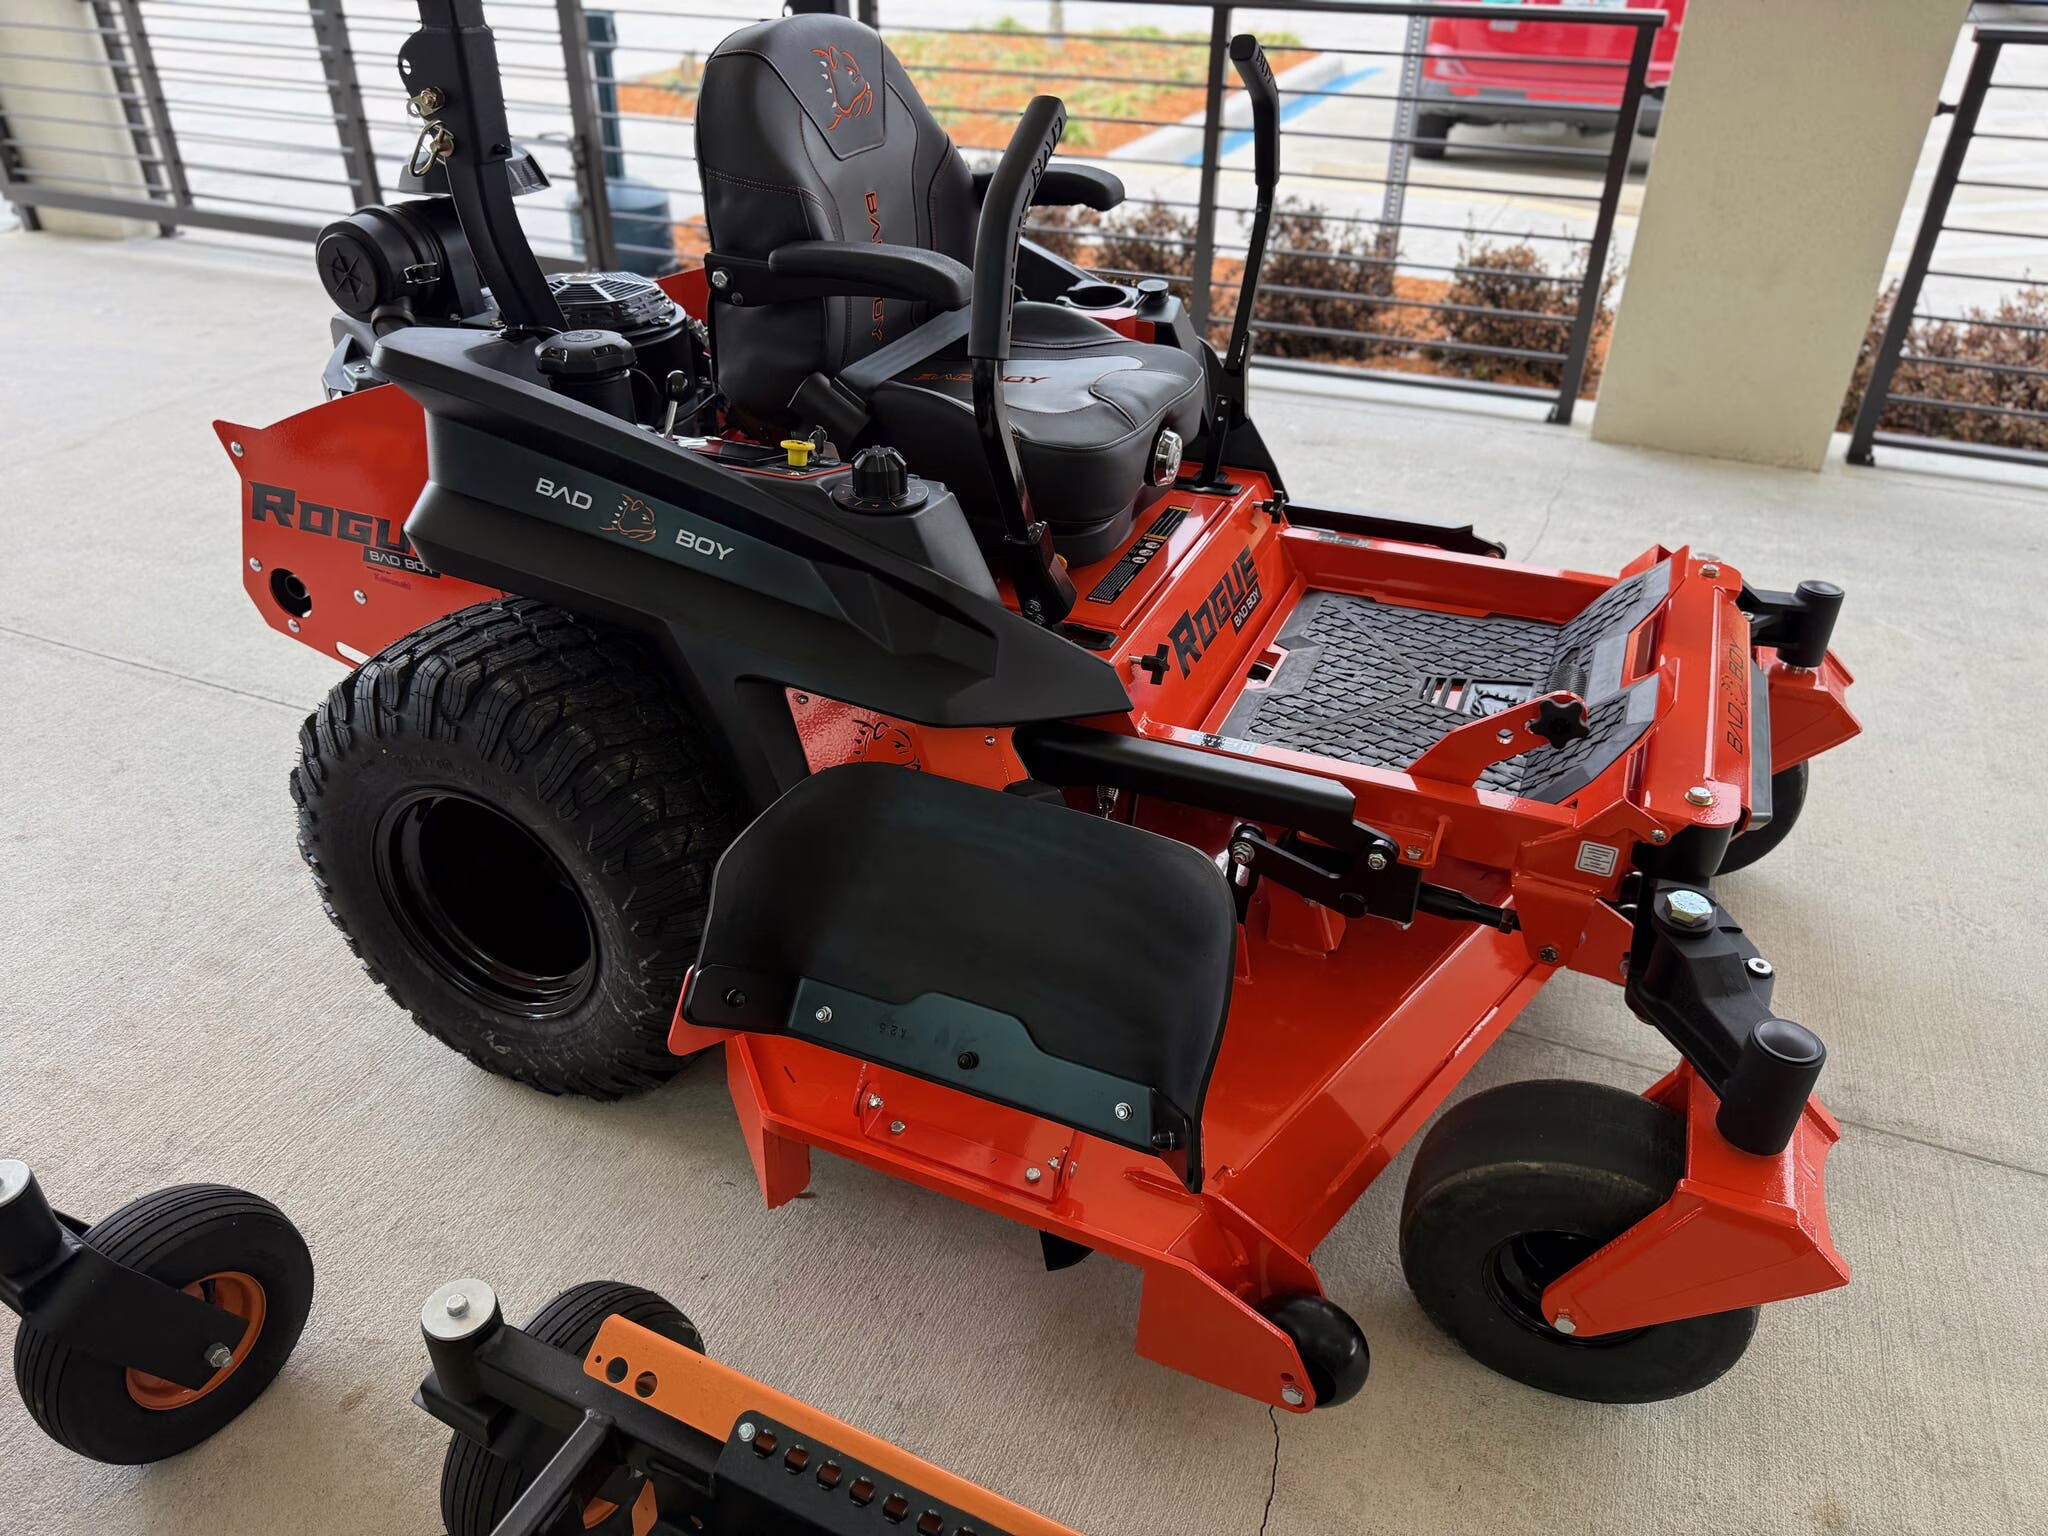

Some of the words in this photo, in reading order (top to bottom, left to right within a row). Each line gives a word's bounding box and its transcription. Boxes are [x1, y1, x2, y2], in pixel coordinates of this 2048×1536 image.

[864, 191, 883, 244] BA
[871, 297, 884, 341] OY
[1003, 375, 1052, 384] OY
[248, 480, 412, 555] ROGU
[535, 477, 593, 510] BAD
[675, 528, 735, 560] BOY
[369, 550, 401, 566] BAD
[1167, 544, 1259, 681] ROGUE
[1233, 605, 1249, 628] BAD
[1245, 586, 1260, 608] BOY
[1728, 633, 1745, 682] BOY
[1727, 701, 1744, 755] BAD
